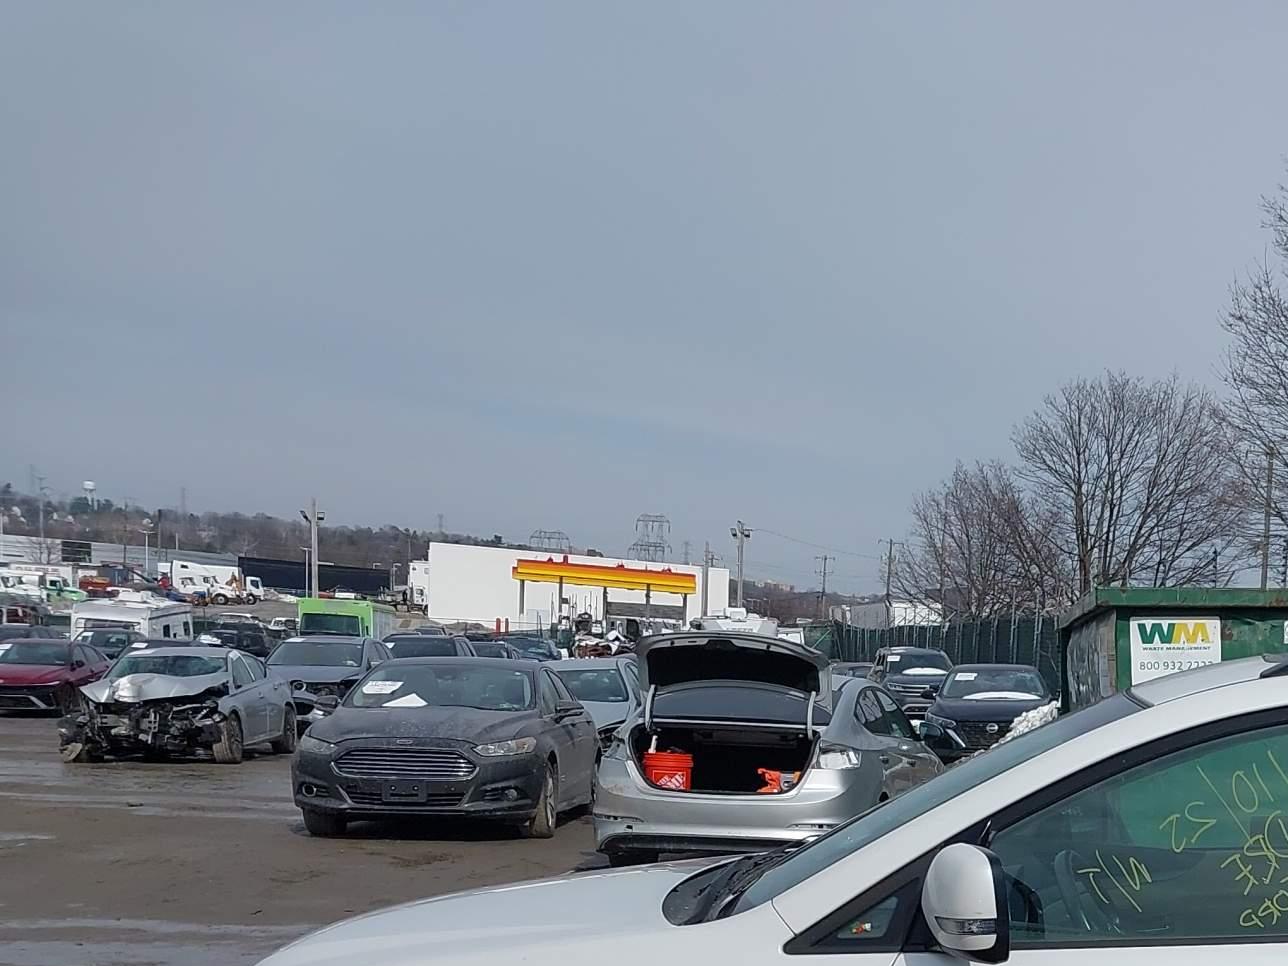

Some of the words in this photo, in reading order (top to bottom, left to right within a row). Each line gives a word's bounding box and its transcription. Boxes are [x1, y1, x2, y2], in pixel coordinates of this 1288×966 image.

[1137, 622, 1211, 645] WM
[1139, 661, 1160, 671] 800
[1162, 661, 1184, 671] 932
